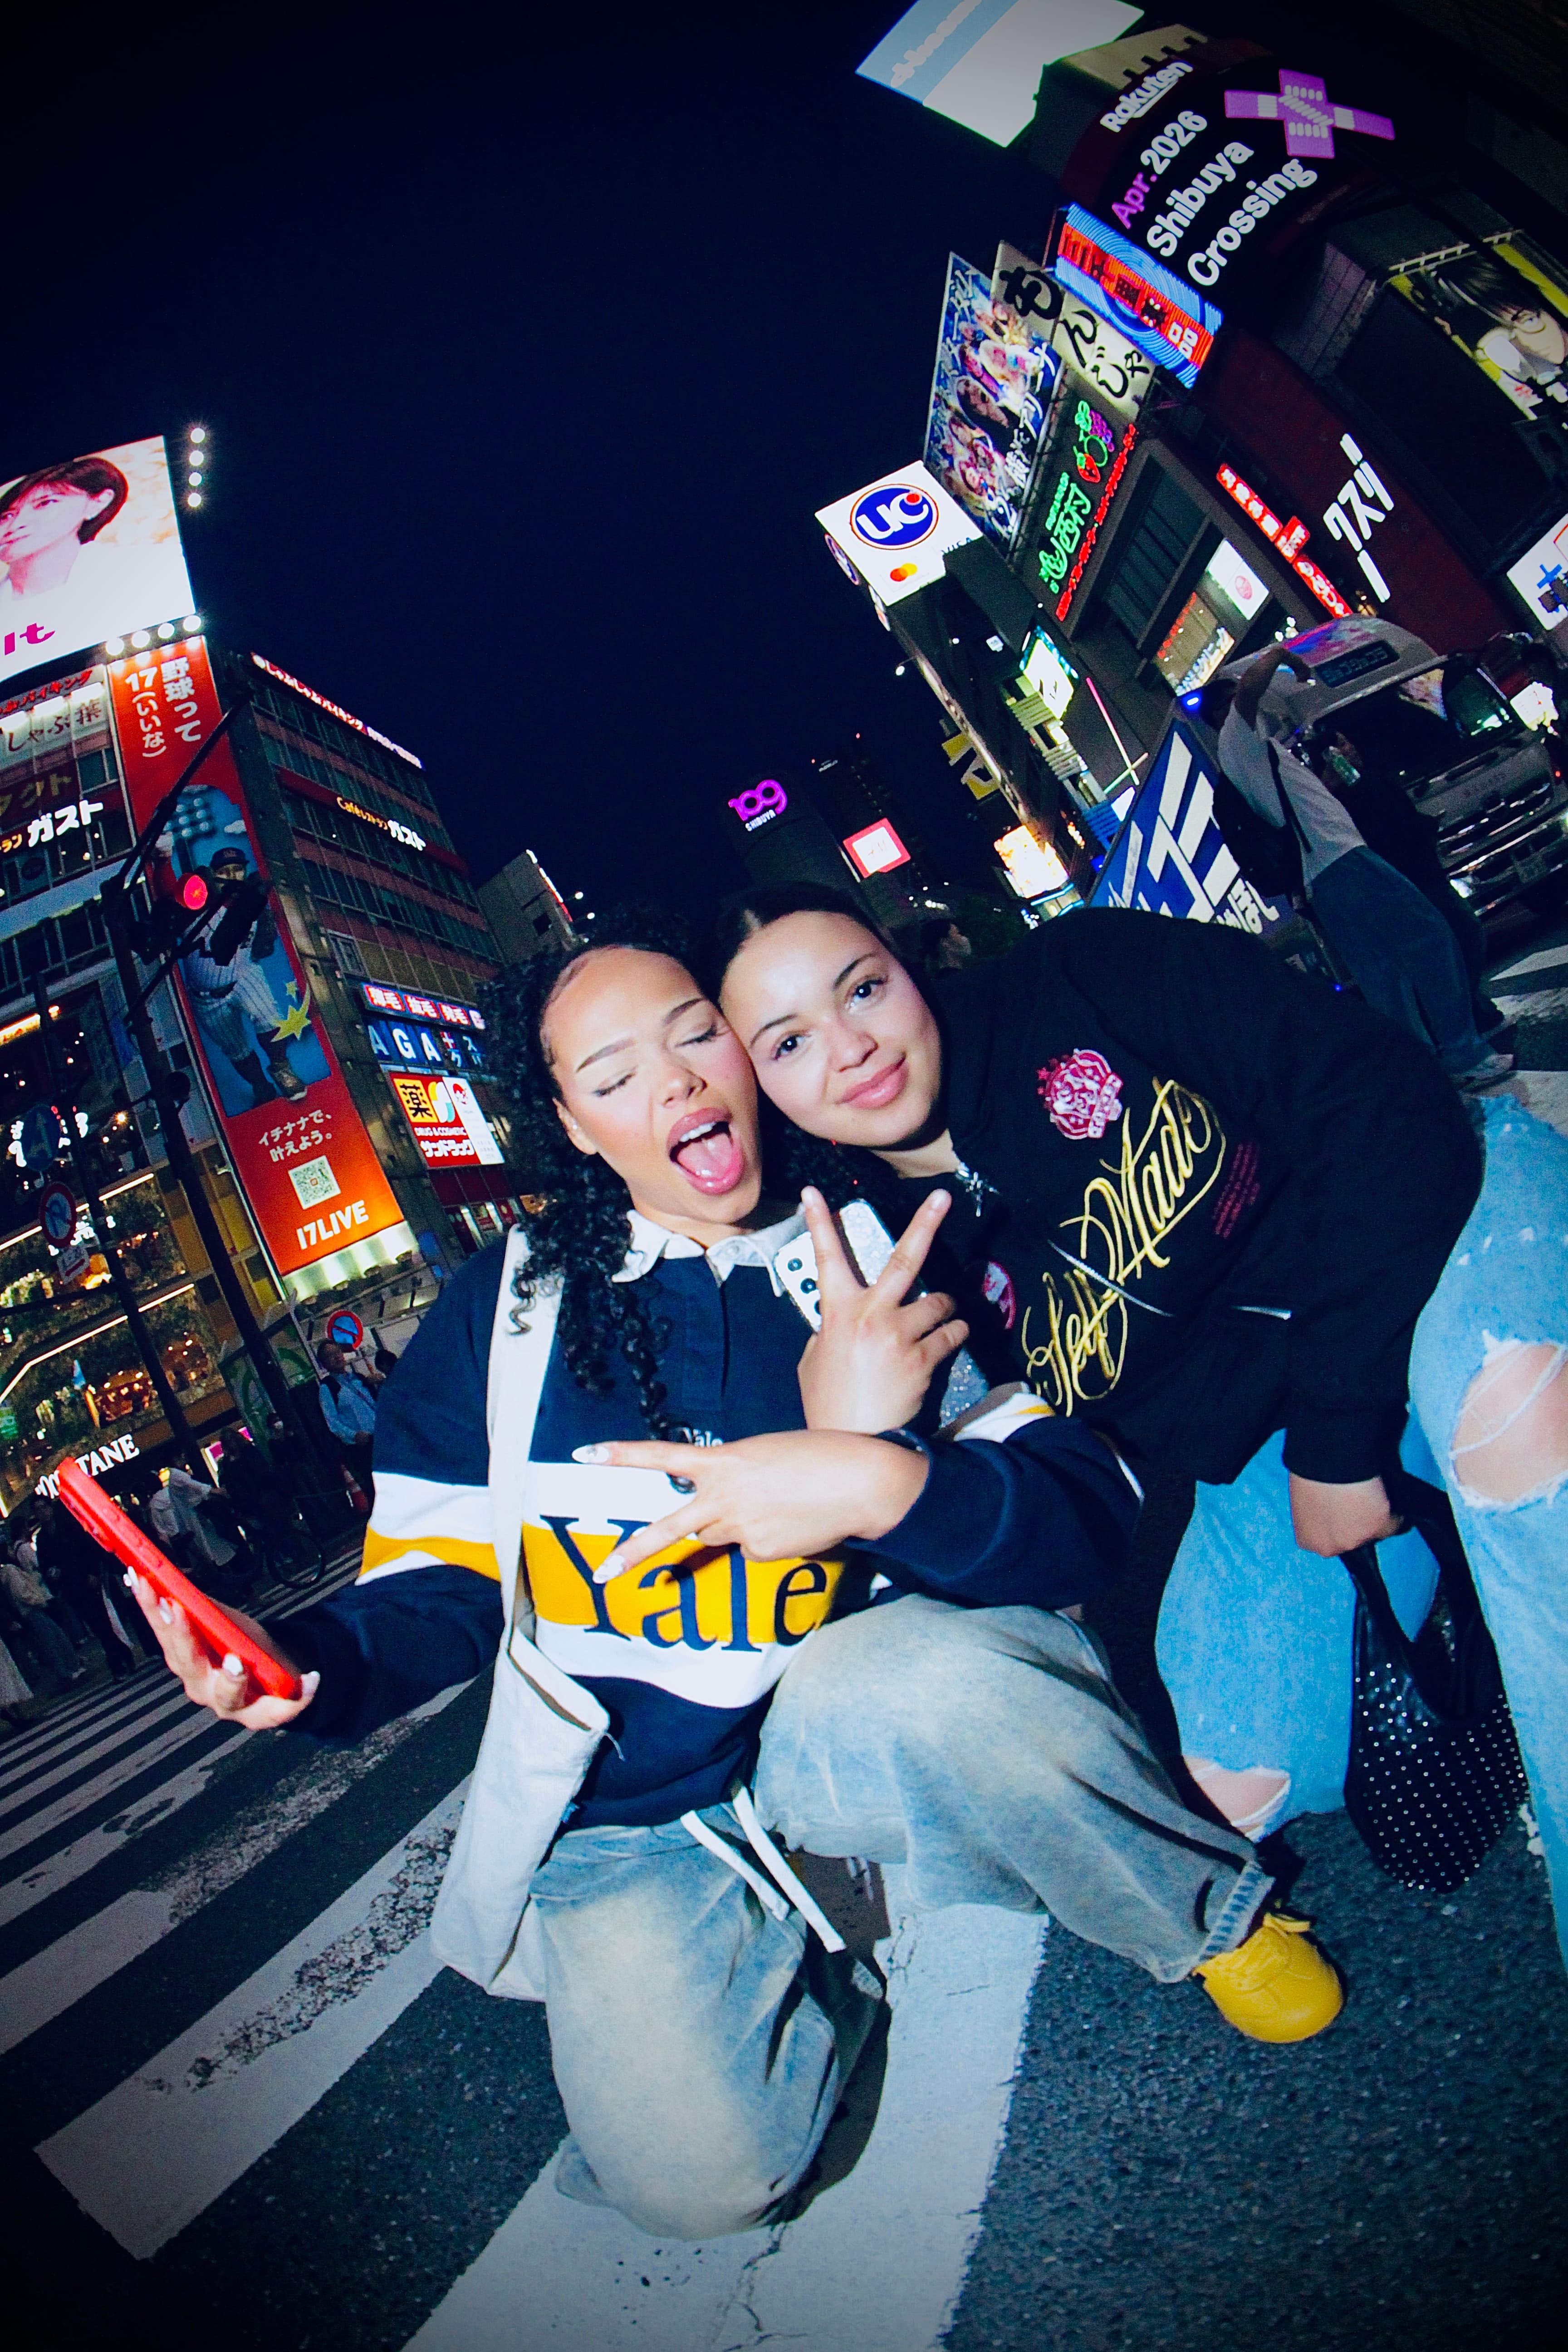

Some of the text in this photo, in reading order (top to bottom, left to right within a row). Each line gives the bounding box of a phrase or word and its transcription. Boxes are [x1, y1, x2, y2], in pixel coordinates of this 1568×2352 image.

[1100, 60, 1193, 133] Rakuten
[1147, 142, 1254, 257] Shibuya
[1188, 159, 1318, 286] Crossing
[1000, 266, 1149, 398] もんじゃ
[857, 493, 928, 539] UC
[1323, 461, 1393, 551] クスリ
[161, 657, 201, 742] 野球って
[728, 779, 787, 821] 109
[745, 809, 776, 831] SHIBUYA
[27, 800, 103, 847] ガスト
[387, 820, 426, 851] ガスト
[368, 1025, 441, 1061] AGA
[400, 1084, 432, 1117] 薬
[259, 1109, 332, 1146] イチナナで、
[270, 1130, 332, 1162] 叶えよう。
[297, 1200, 369, 1250] 17LIVE
[681, 1428, 724, 1447] Yale
[540, 1514, 827, 1652] Yale
